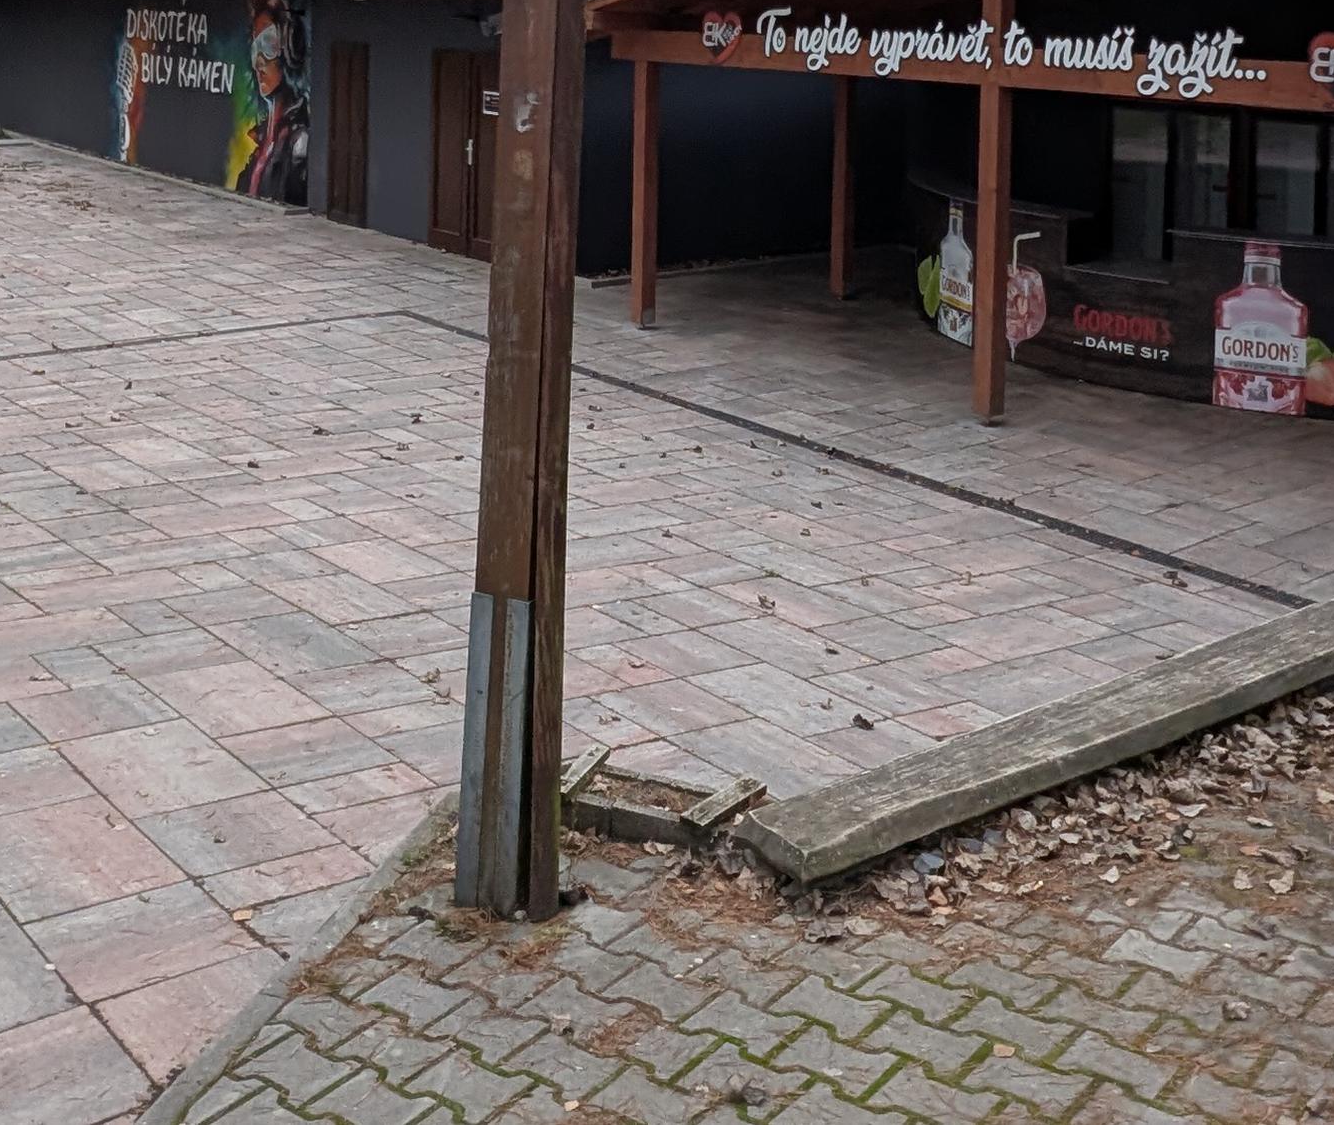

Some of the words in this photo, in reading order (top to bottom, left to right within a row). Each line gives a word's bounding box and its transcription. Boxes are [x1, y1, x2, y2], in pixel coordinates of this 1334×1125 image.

[141, 43, 172, 85] BÍLÝ
[177, 47, 235, 94] KÁMEN
[756, 7, 792, 57] To
[794, 13, 862, 71] nejde
[869, 19, 994, 76] vyprávět,
[1004, 19, 1033, 66] to
[1044, 27, 1135, 71] musíš
[1136, 28, 1267, 99] zažít...
[1140, 346, 1170, 361] SI?
[1221, 336, 1299, 363] GORDON'S
